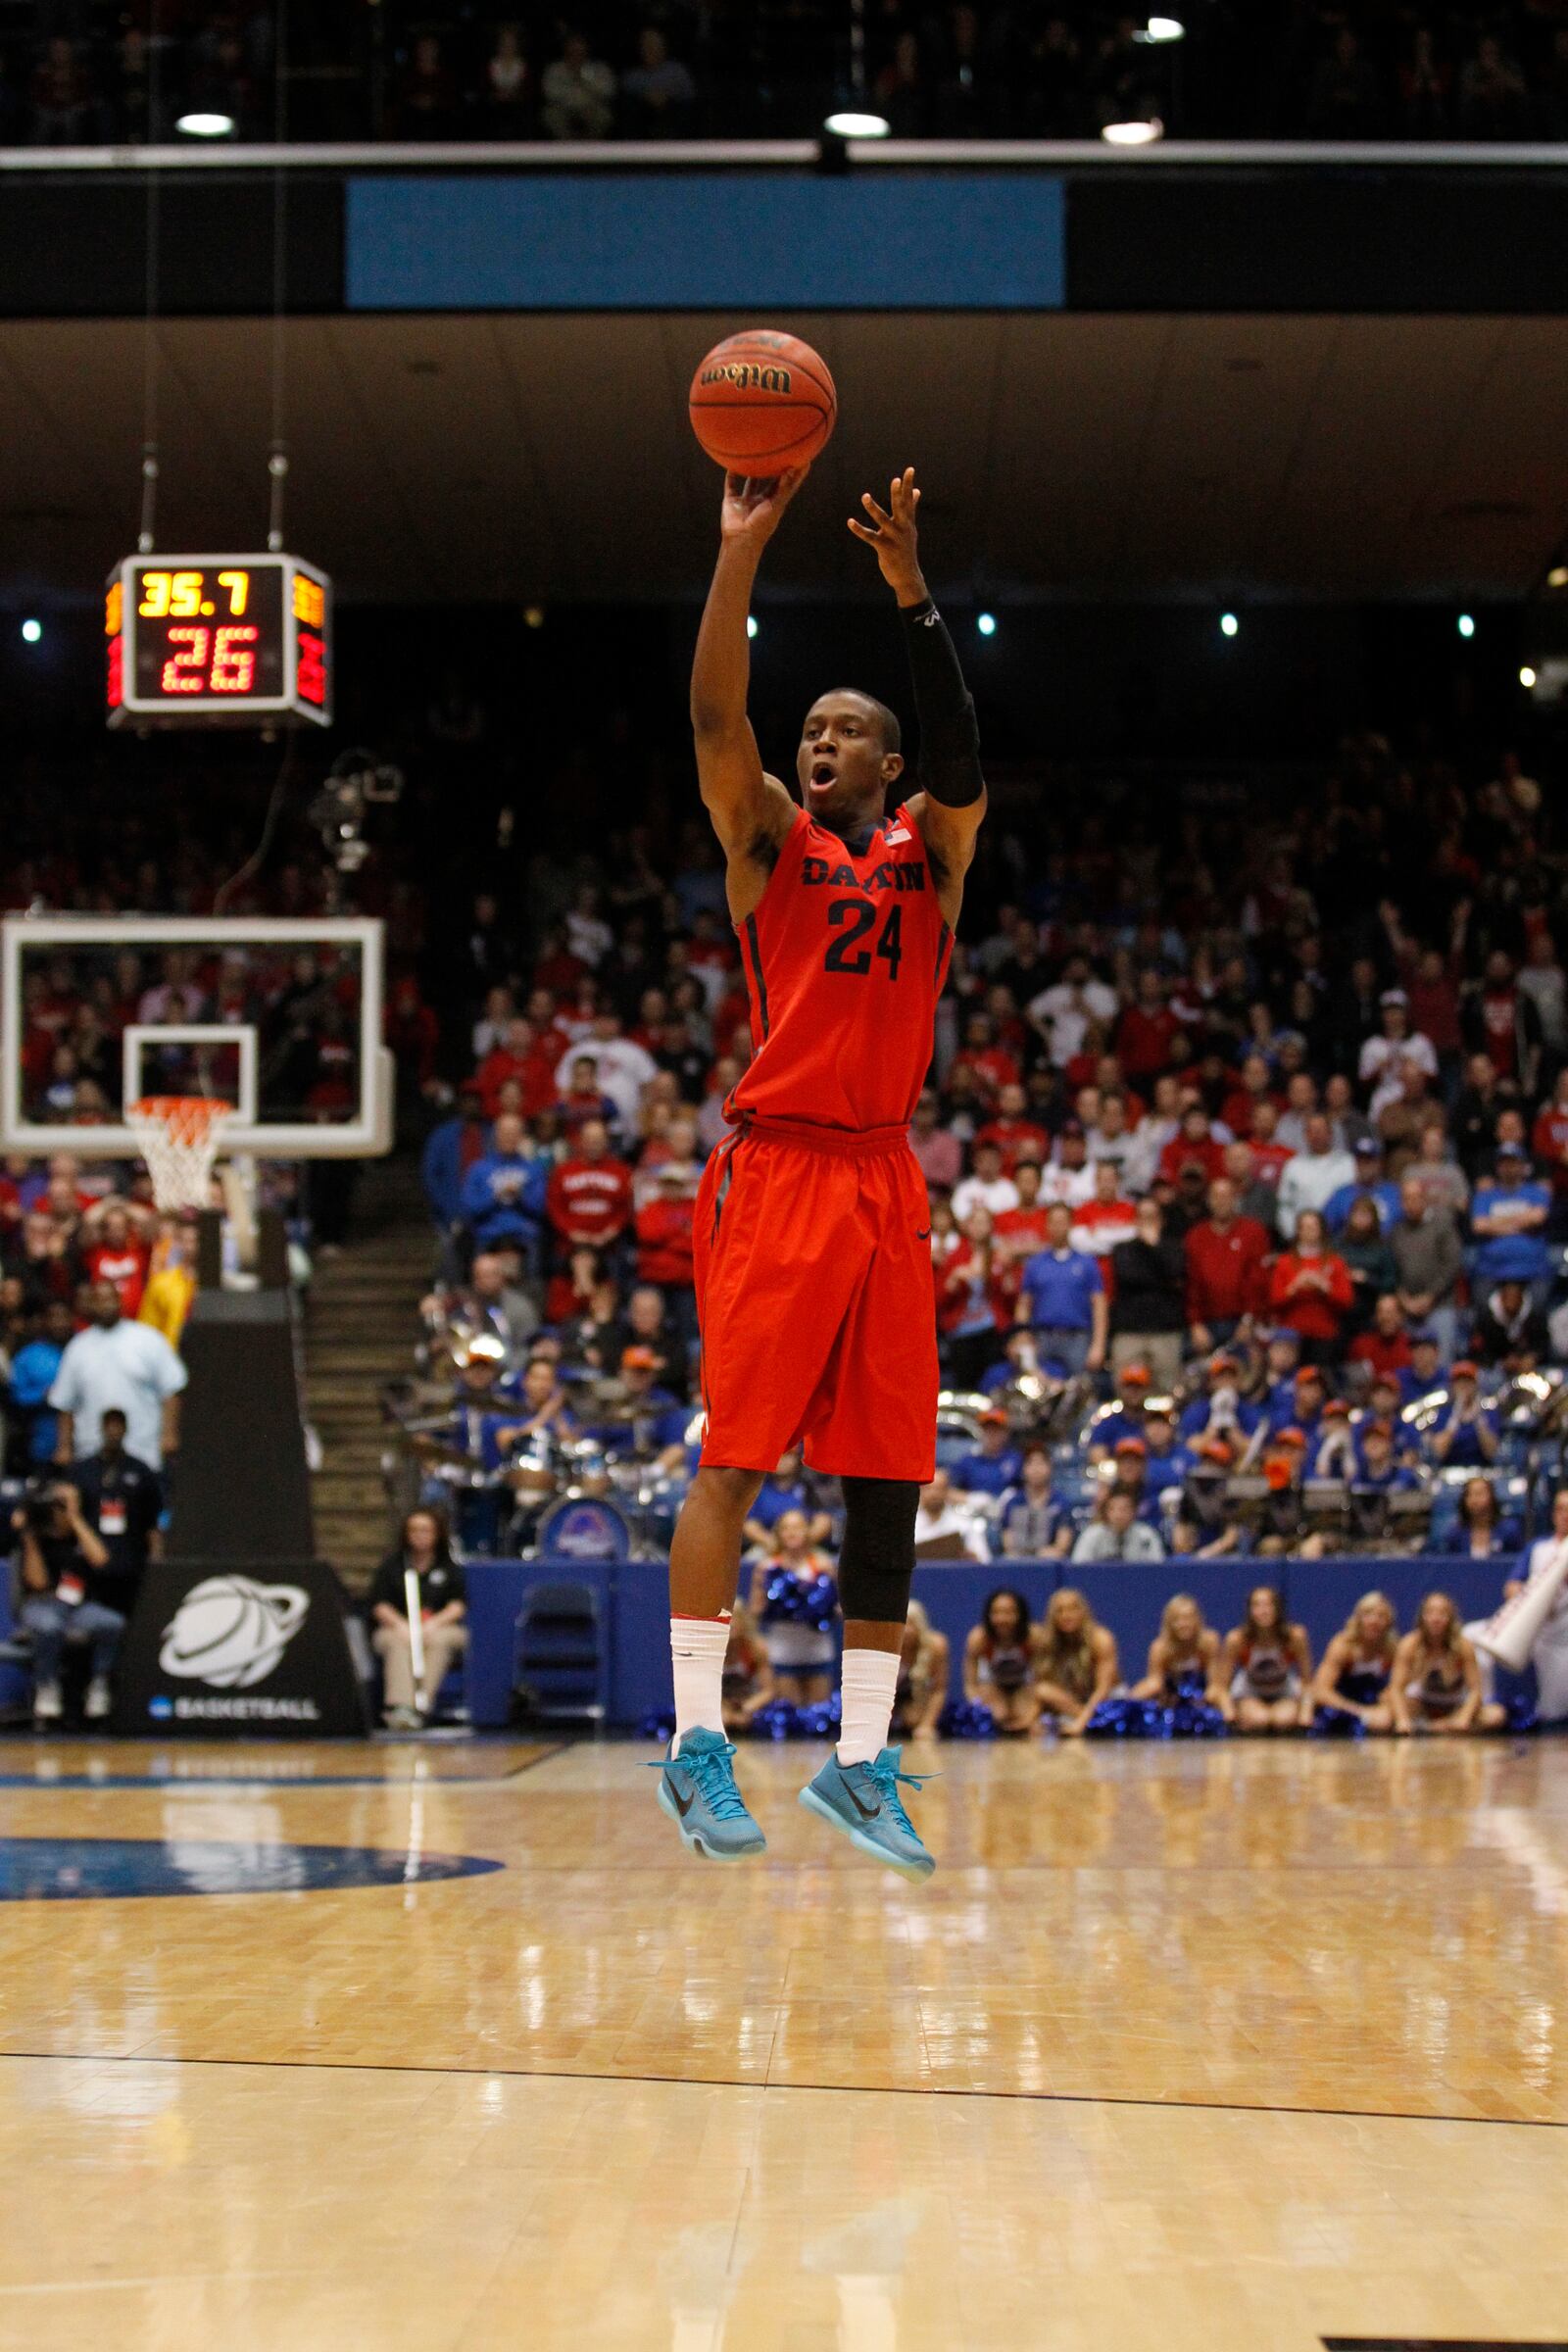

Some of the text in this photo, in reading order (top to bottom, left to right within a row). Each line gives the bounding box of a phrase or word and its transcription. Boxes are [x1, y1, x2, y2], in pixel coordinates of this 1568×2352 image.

[701, 363, 792, 395] Wilson
[138, 570, 250, 617] 35.7
[161, 625, 259, 693] 26
[824, 899, 903, 982] 24
[174, 1696, 319, 1720] BASKETBALL
